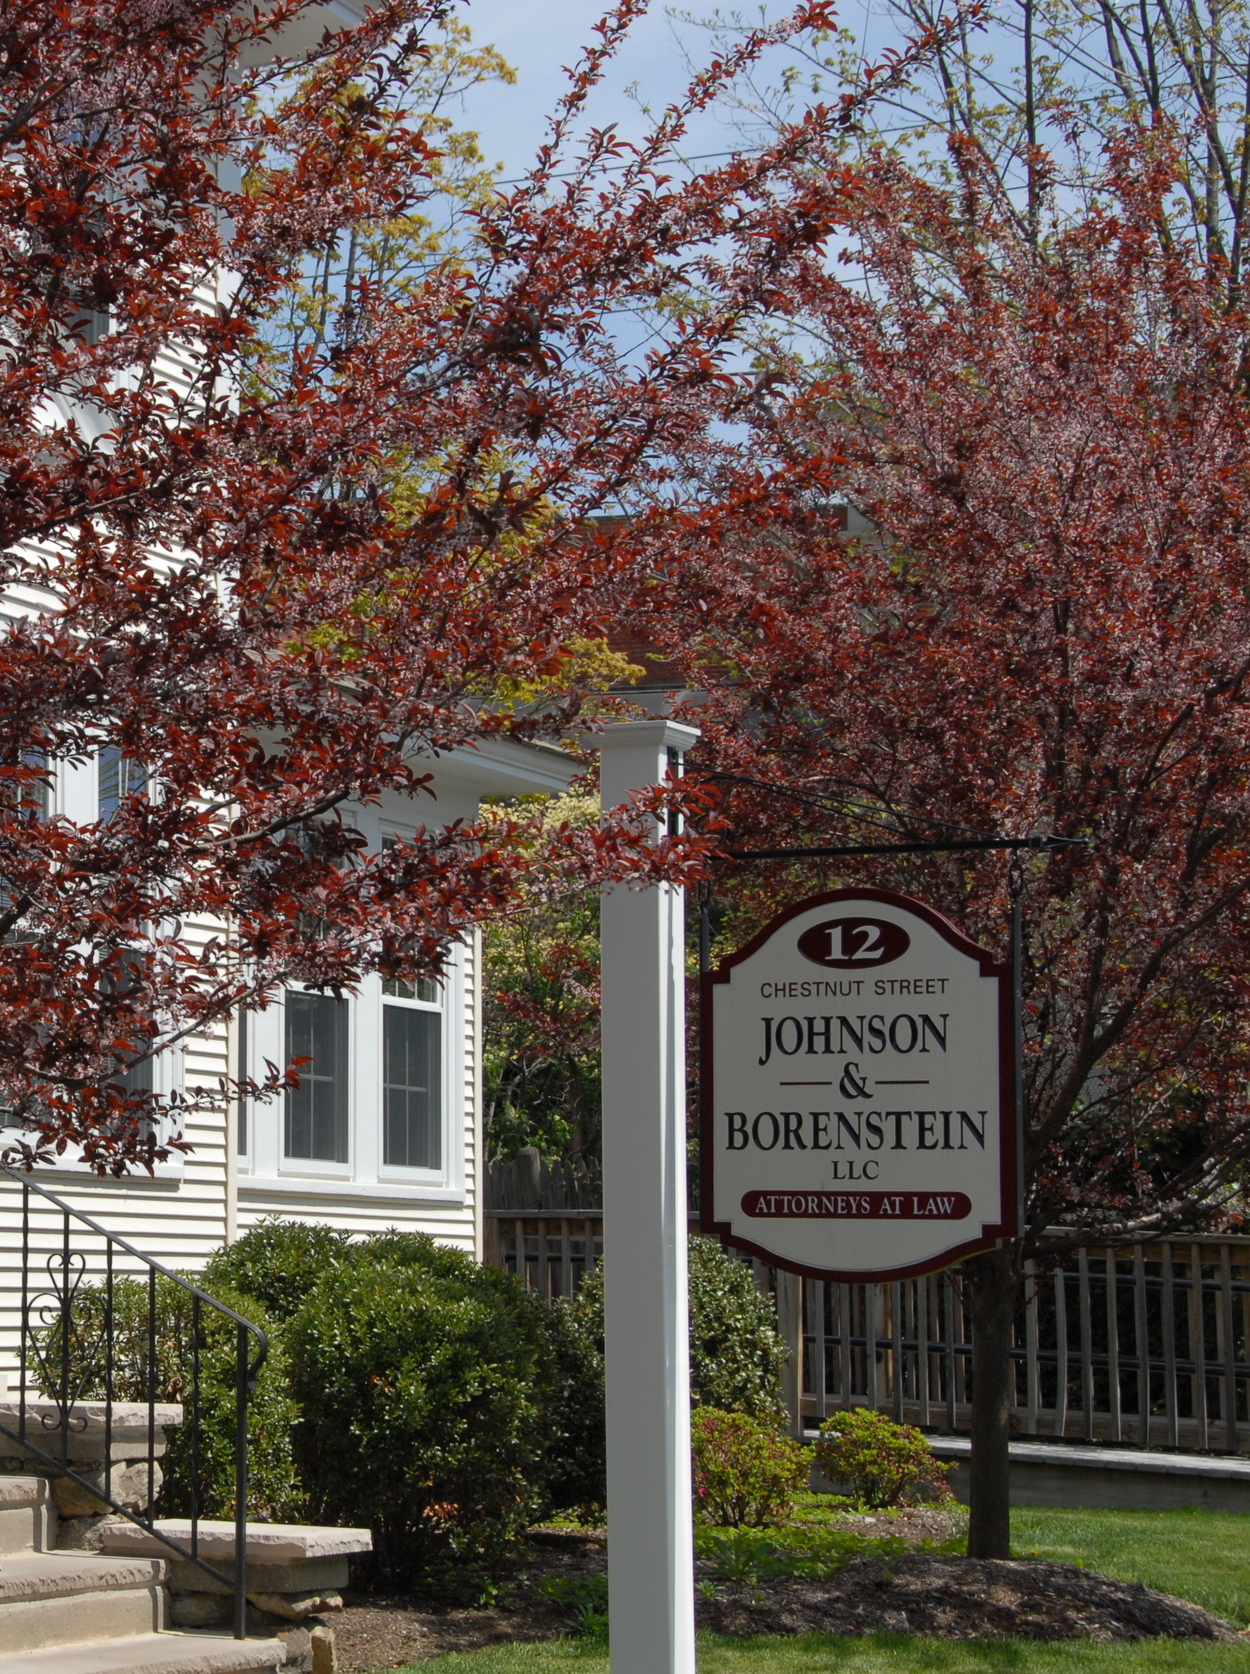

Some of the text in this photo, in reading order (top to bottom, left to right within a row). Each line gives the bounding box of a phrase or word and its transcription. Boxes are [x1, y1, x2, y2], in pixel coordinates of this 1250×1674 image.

[824, 925, 885, 960] 12
[760, 978, 950, 999] CHESTNUT STREET
[758, 1013, 950, 1066] JOHNSON
[839, 1061, 874, 1100] &
[724, 1110, 988, 1151] BORENSTEIN
[831, 1160, 880, 1181] LLC
[755, 1195, 956, 1215] ATTORNEYS AT LAW
